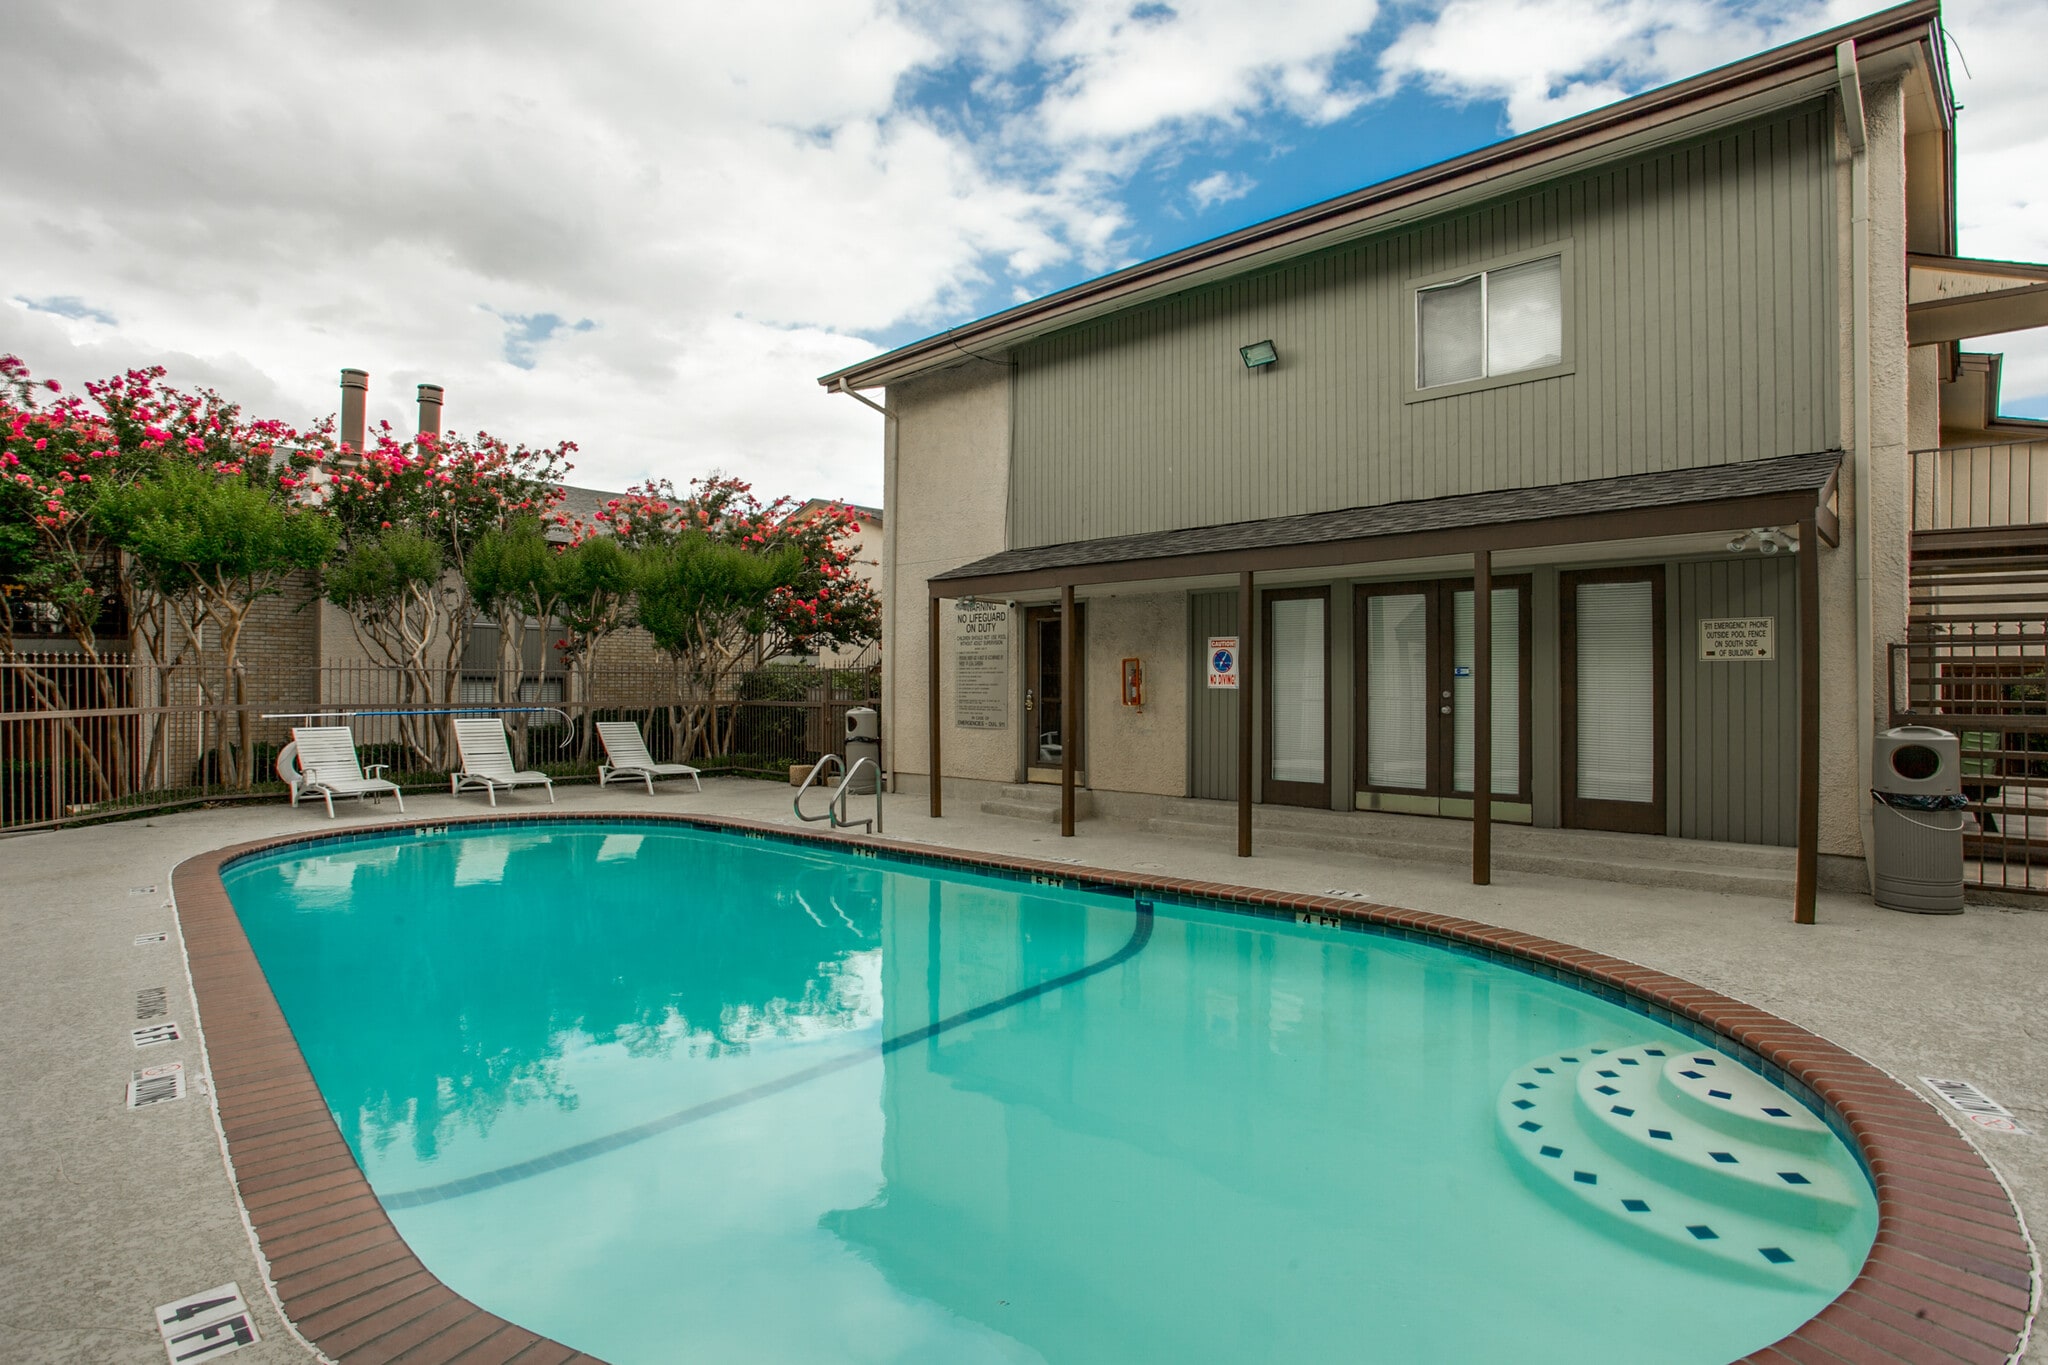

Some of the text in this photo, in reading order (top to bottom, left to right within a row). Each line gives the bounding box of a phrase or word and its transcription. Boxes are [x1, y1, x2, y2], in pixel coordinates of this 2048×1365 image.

[957, 611, 1006, 624] NO LIFEGUARD
[966, 622, 996, 633] ON DUTY
[1704, 620, 1769, 630] 911 EMERGENCY PHONE
[1706, 629, 1766, 639] OUTSIDE POOL FENCE
[1211, 640, 1237, 648] CAUTION!
[1715, 639, 1758, 648] ON SOUTH SIDE
[1719, 649, 1754, 657] OF BUILDING
[1210, 674, 1217, 685] NO
[1048, 878, 1061, 887] FT
[1320, 916, 1339, 927] FT
[133, 1024, 179, 1047] 5 FT
[163, 1295, 254, 1362] 4 FT
